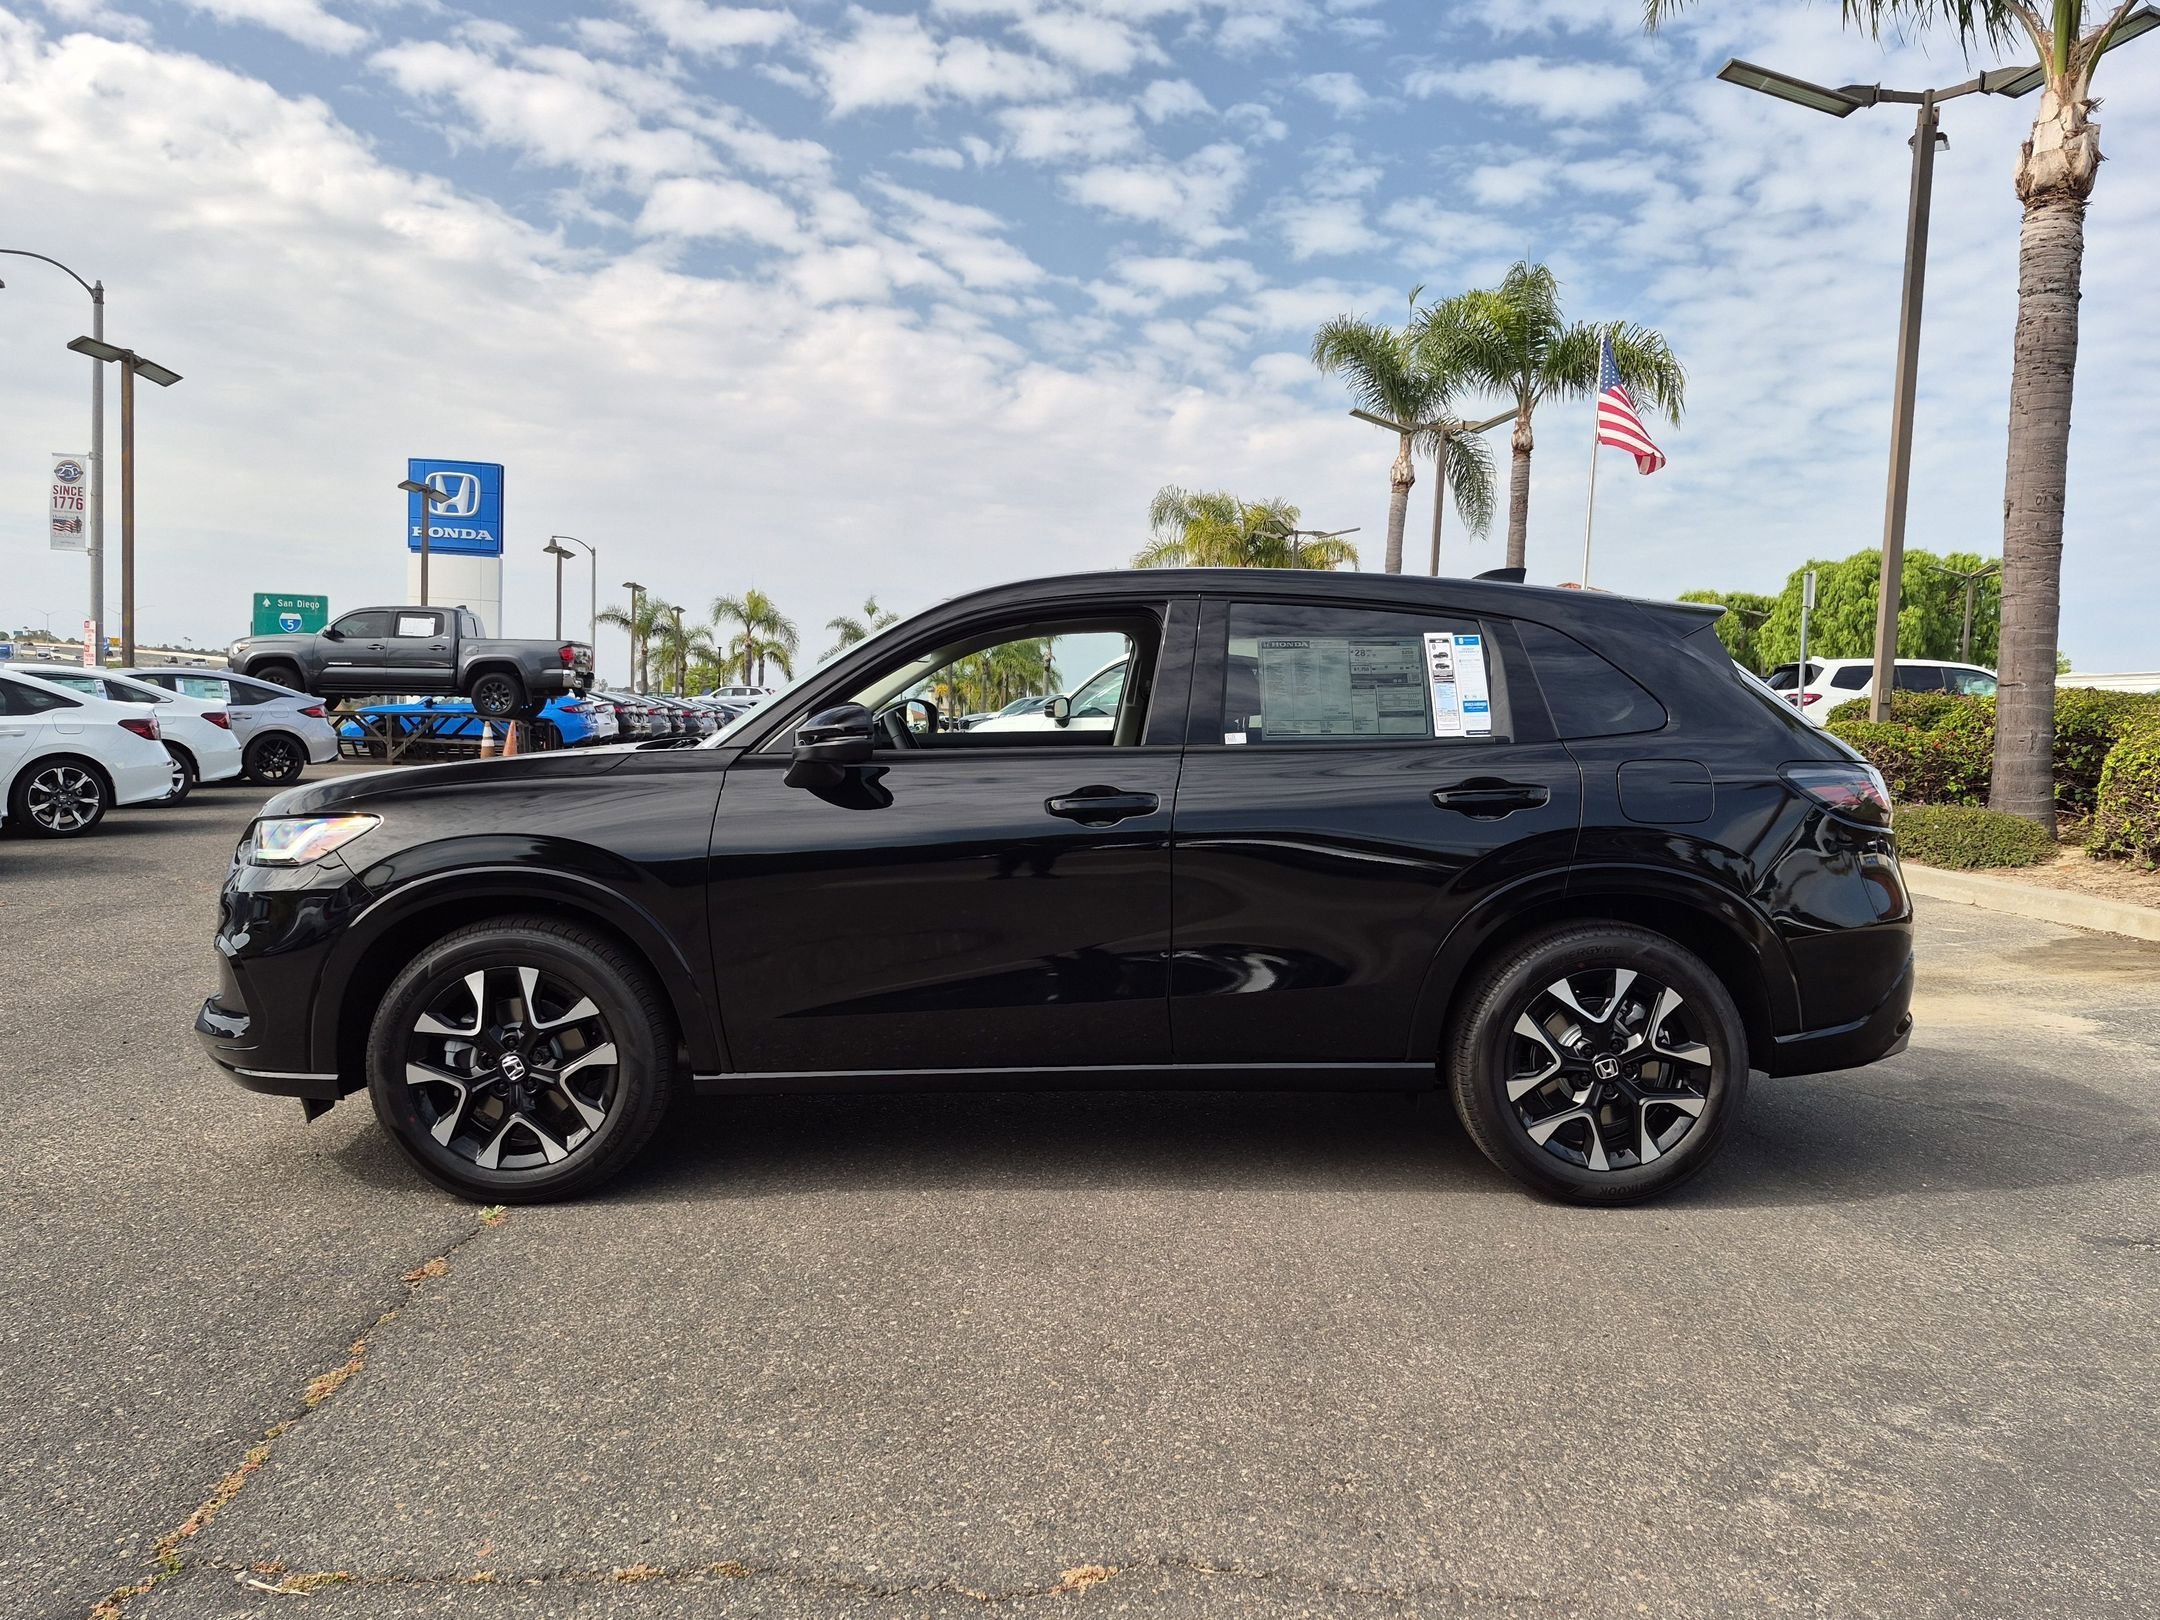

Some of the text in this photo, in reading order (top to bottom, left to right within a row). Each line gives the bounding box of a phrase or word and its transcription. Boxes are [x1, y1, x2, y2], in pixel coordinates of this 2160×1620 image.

[52, 484, 84, 496] SINCE
[52, 496, 84, 510] 1776
[411, 526, 494, 541] HONDA
[277, 598, 320, 611] San Diego
[287, 619, 295, 630] 5
[1270, 641, 1309, 649] HONDA
[1354, 649, 1367, 657] 28
